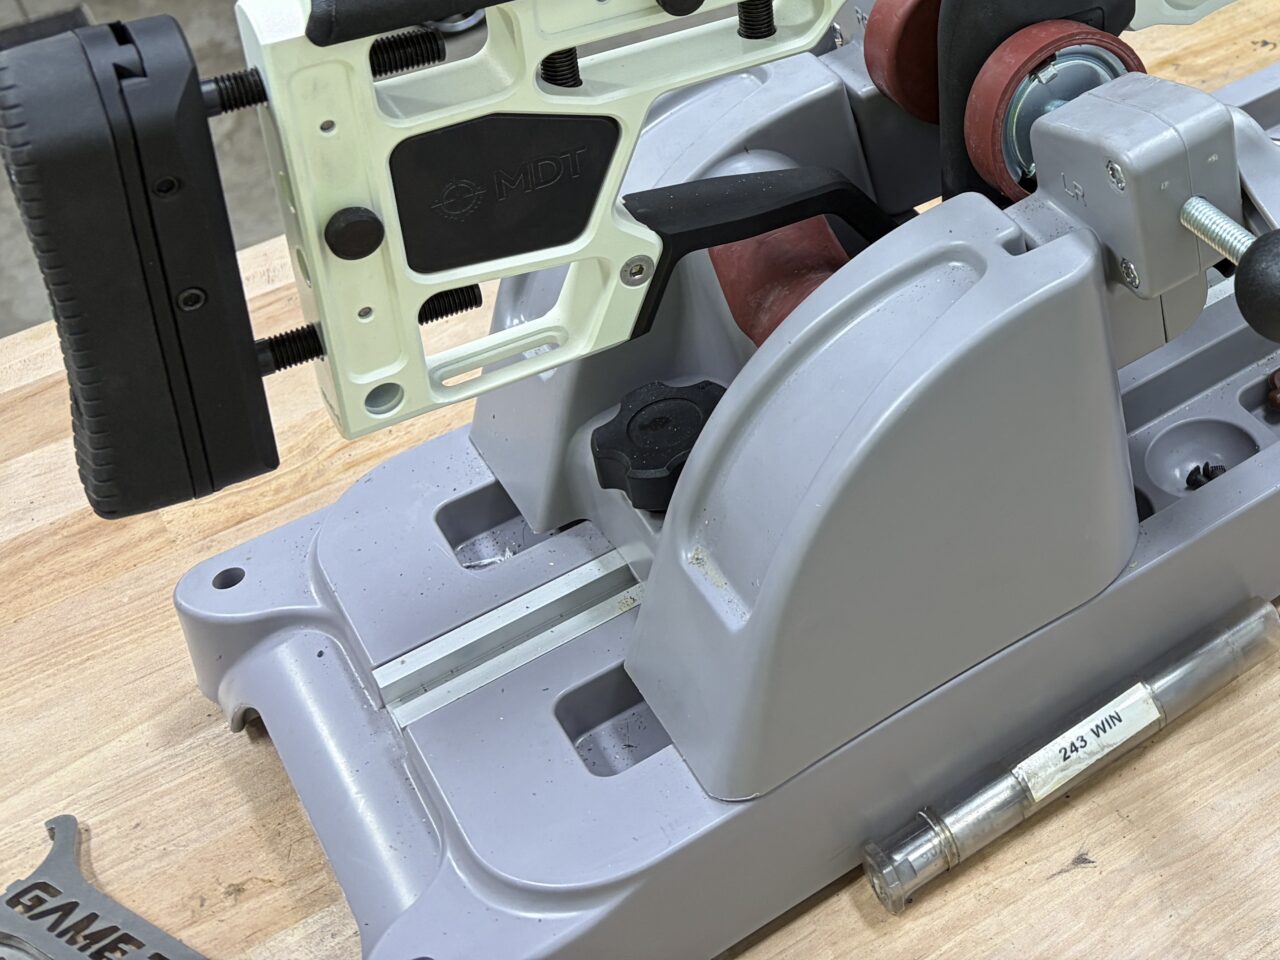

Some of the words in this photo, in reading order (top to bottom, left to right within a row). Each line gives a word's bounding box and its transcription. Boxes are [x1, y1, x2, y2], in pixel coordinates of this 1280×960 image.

[493, 146, 588, 202] MDT
[1058, 735, 1089, 762] 243
[1090, 710, 1123, 739] WIN
